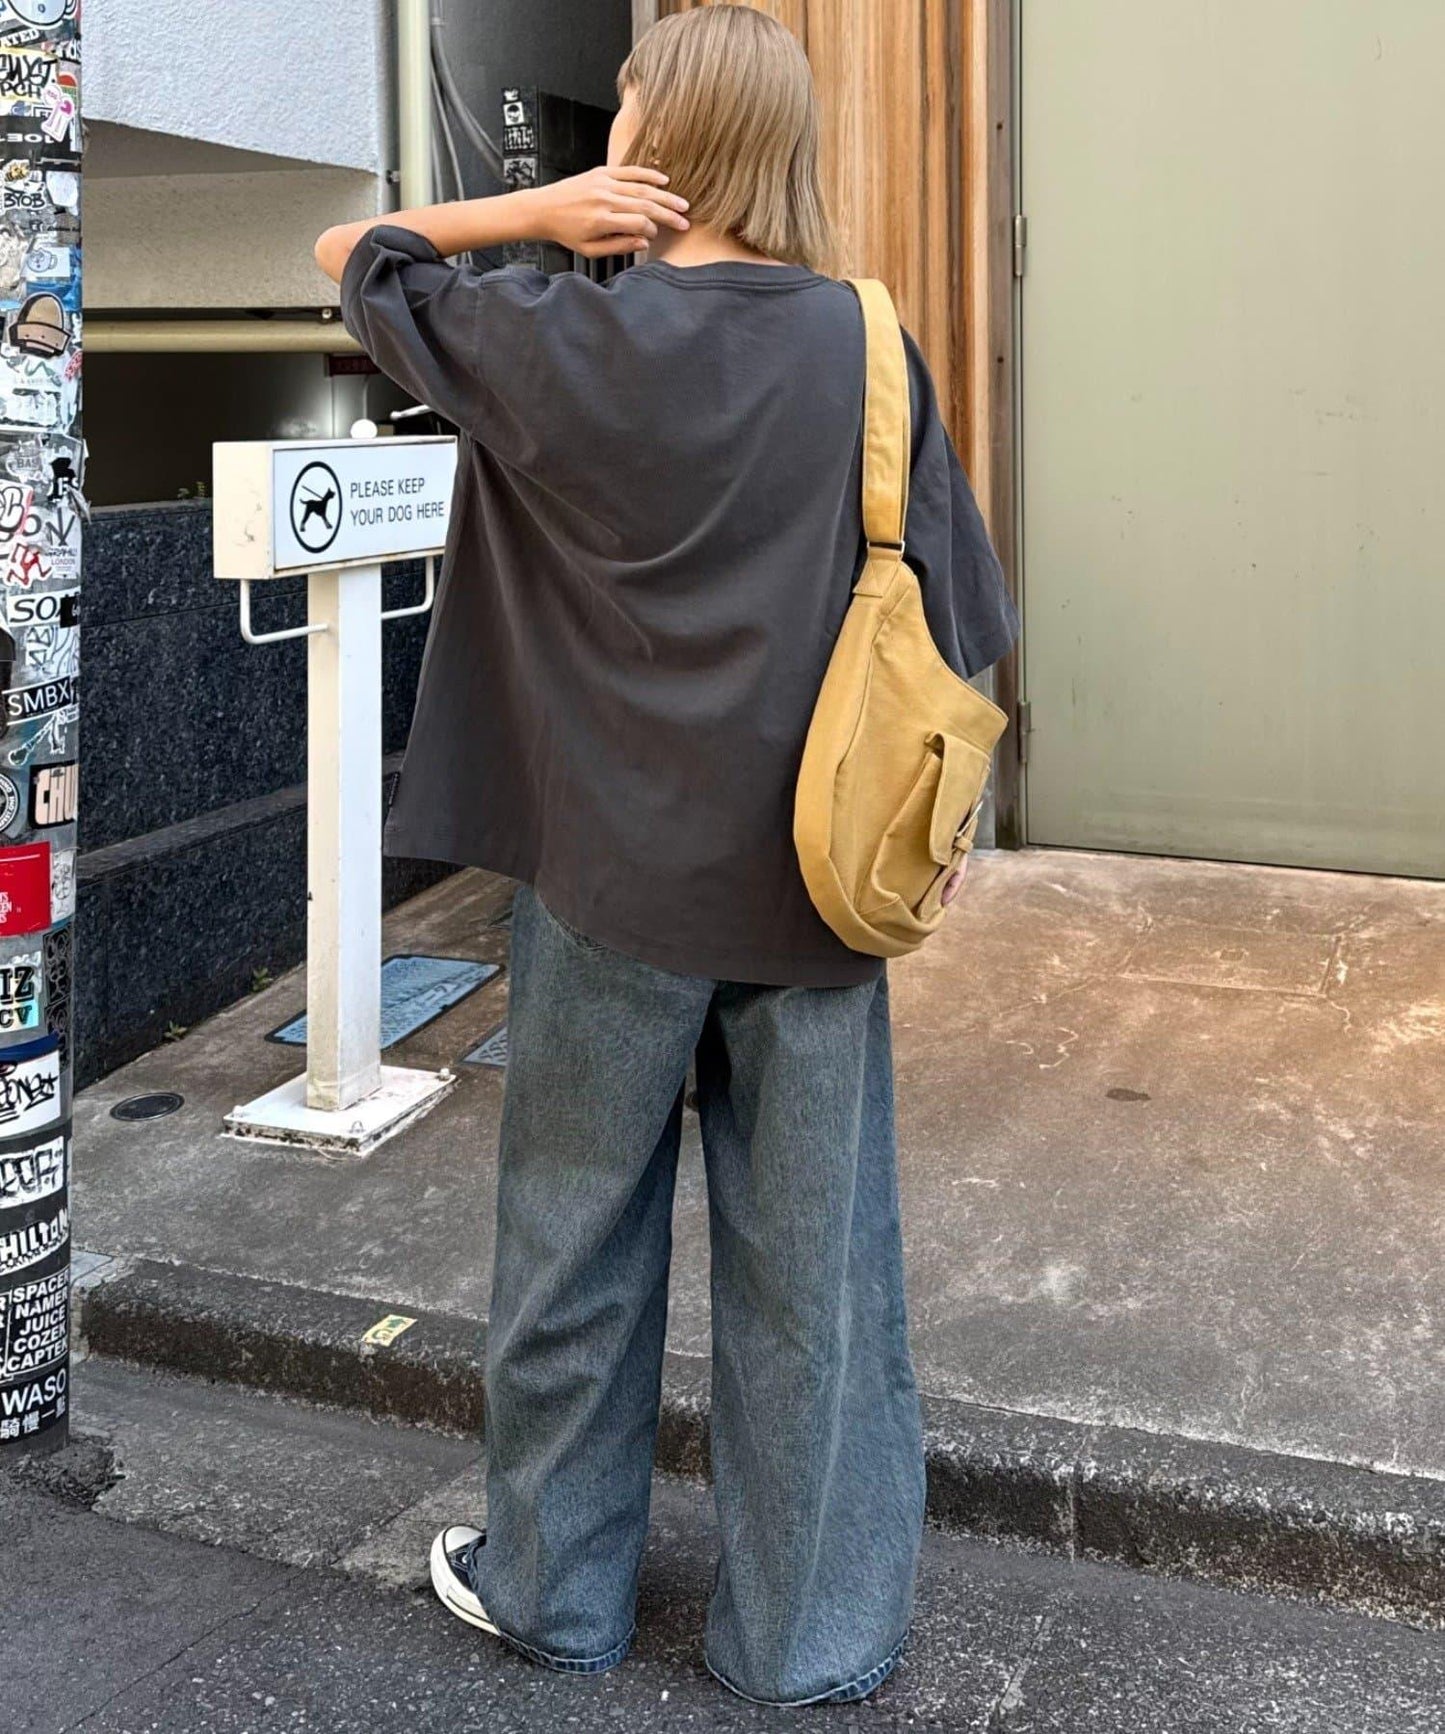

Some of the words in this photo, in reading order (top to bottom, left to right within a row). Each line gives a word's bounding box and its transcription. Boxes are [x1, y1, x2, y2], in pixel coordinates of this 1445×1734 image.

[350, 479, 395, 499] PLEASE
[397, 477, 426, 495] KEEP
[350, 506, 384, 527] YOUR
[388, 504, 413, 523] DOG
[416, 500, 445, 519] HERE
[8, 679, 70, 716] SMBX
[19, 1304, 66, 1336] JUICE
